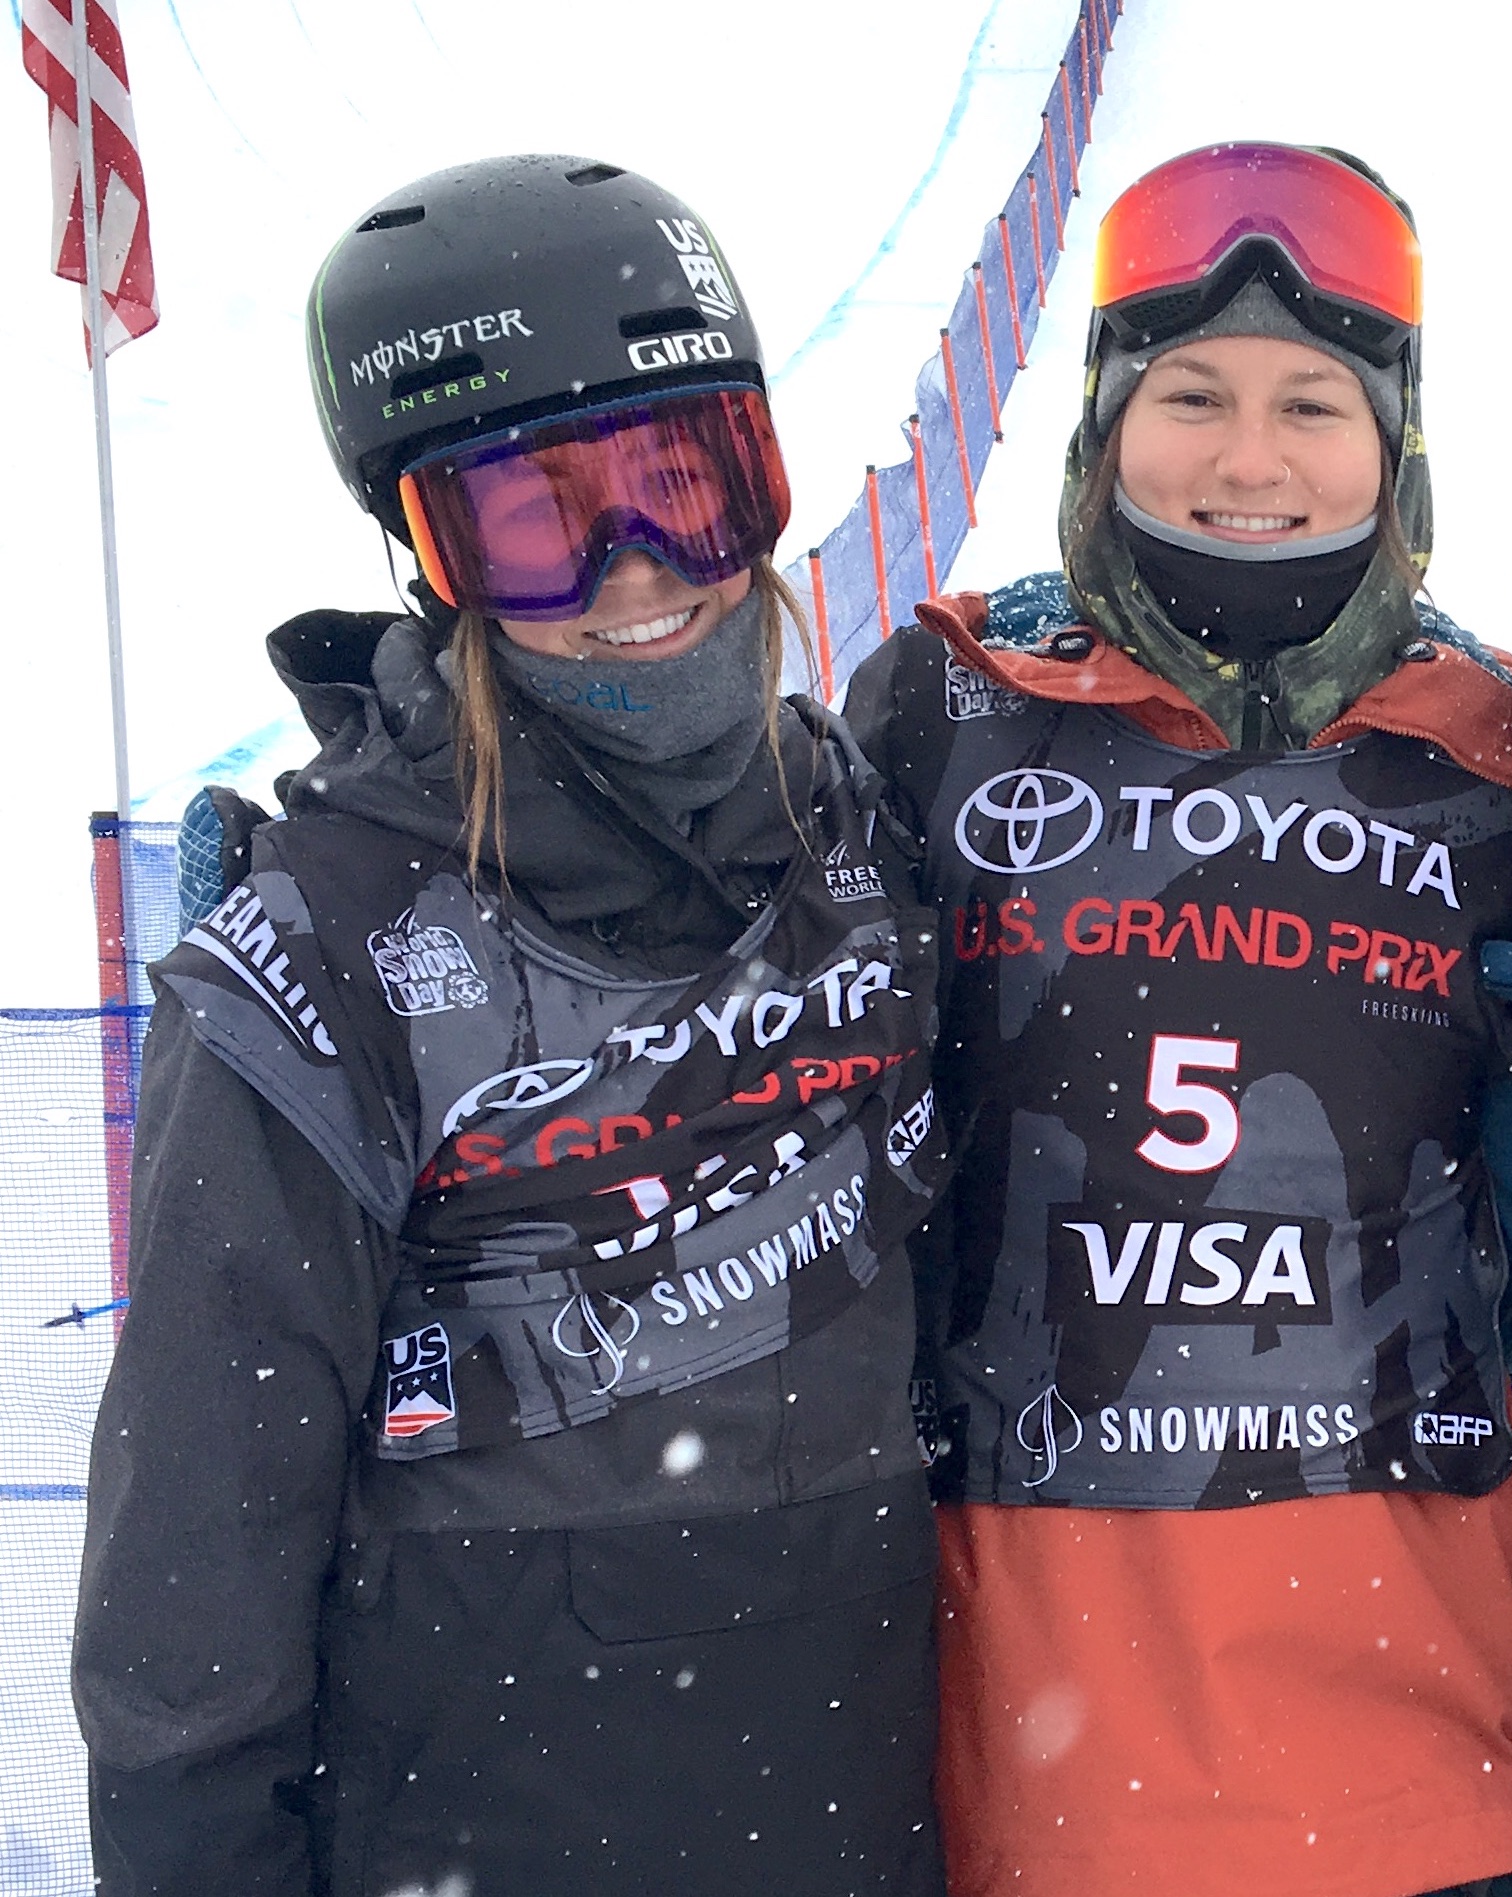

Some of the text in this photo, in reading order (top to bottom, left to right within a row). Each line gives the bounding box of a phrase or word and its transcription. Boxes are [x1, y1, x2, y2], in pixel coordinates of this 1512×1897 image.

[655, 218, 709, 254] US
[627, 331, 733, 371] GIRO
[382, 368, 510, 419] ENERGY
[1119, 786, 1461, 910] TOYOTA
[825, 865, 881, 886] FREE
[953, 897, 1462, 997] U.S. GRAND PRIX
[397, 980, 446, 1010] Day
[605, 958, 912, 1062] TOYOTA
[1362, 1000, 1450, 1028] FREESKIING
[1135, 1034, 1240, 1174] 5
[650, 1173, 867, 1327] SNOWMASS
[1061, 1222, 1316, 1306] VISA
[385, 1327, 447, 1376] US
[1100, 1403, 1359, 1454] SNOWMASS
